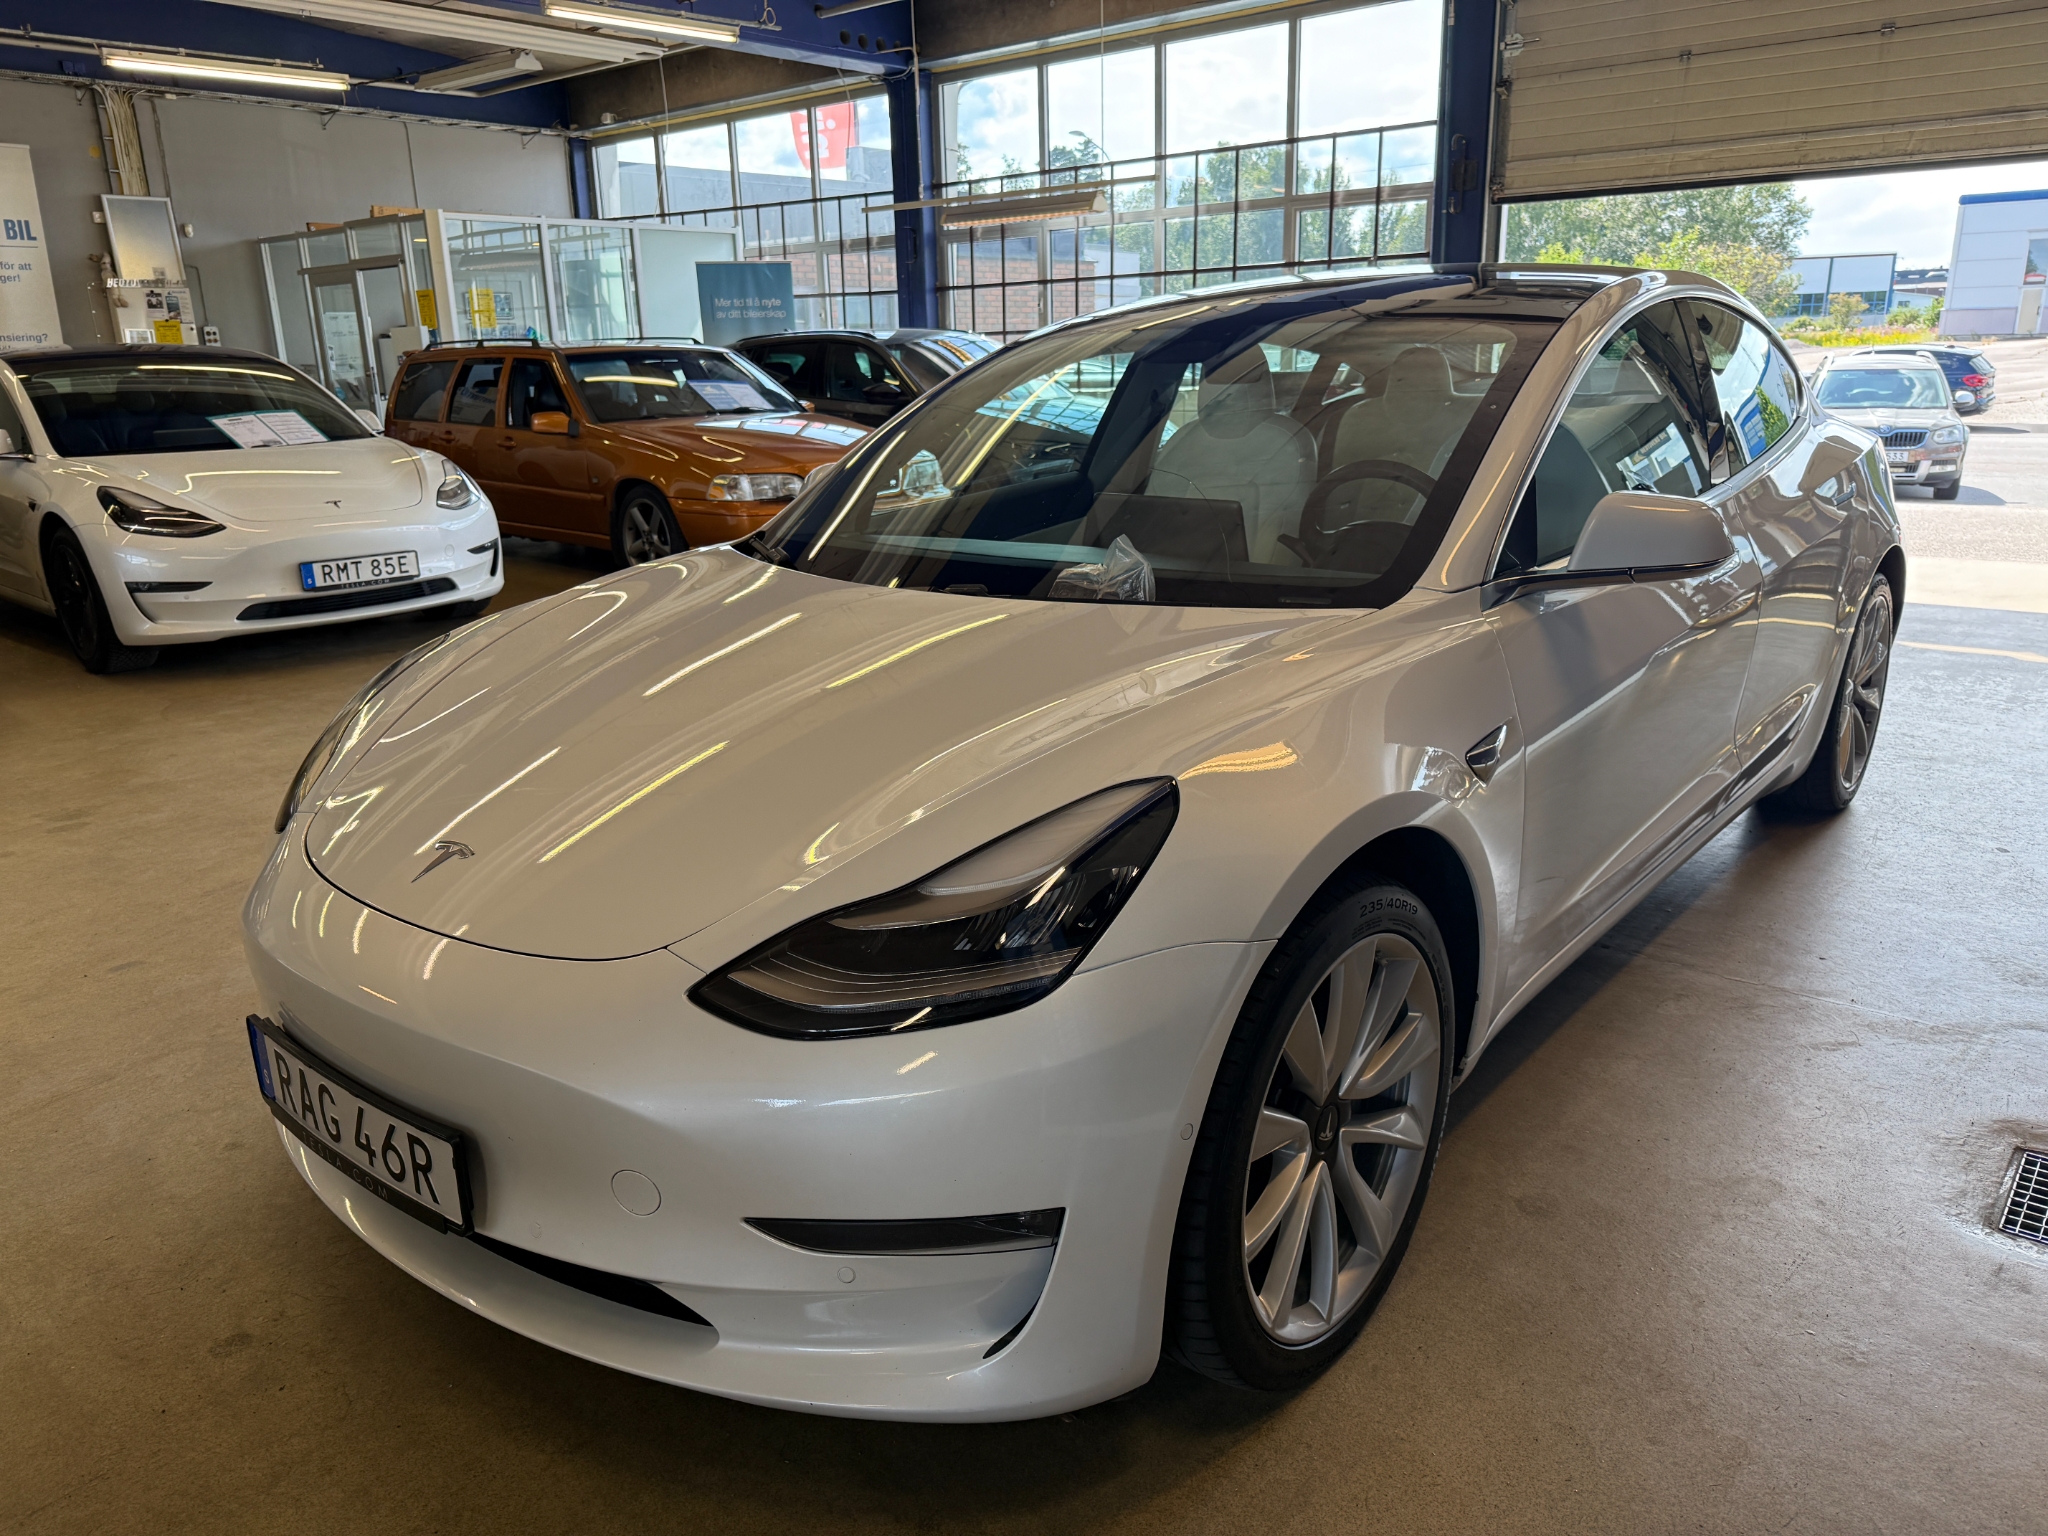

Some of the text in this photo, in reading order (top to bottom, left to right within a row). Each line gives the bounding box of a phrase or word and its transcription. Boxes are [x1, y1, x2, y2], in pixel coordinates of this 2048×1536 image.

[3, 219, 37, 241] BIL
[18, 262, 32, 271] att
[715, 298, 732, 307] Mer
[733, 298, 744, 307] tid
[754, 297, 760, 307] å
[761, 298, 781, 308] nyte
[716, 311, 727, 319] av
[728, 309, 741, 318] ditt
[321, 561, 363, 583] RMT
[371, 556, 409, 577] 85E
[1359, 897, 1419, 919] 235/40R19
[263, 1048, 440, 1205] S RAG 46R
[302, 1131, 389, 1201] TESLA.COM
